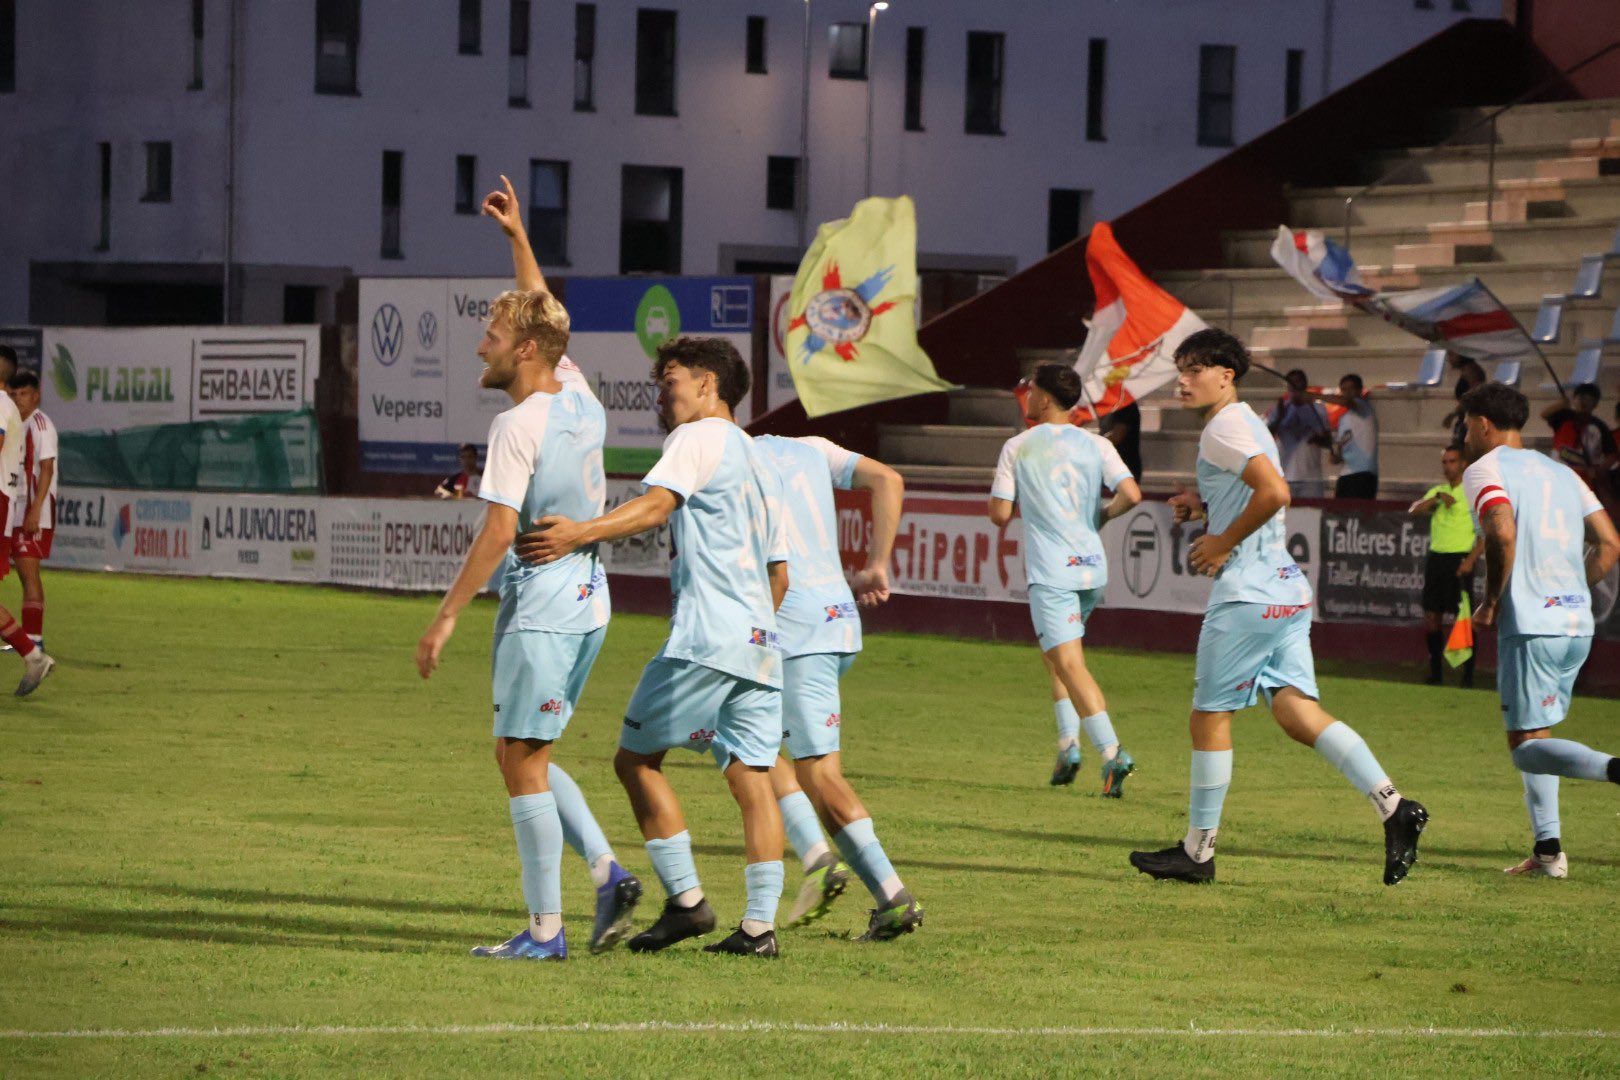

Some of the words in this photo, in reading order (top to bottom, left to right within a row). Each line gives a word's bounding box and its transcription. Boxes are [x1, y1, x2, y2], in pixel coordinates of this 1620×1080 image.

[454, 294, 489, 322] Vep
[200, 369, 296, 400] EMBALAXE
[598, 371, 658, 411] buscas
[372, 394, 443, 422] Vepersa
[216, 506, 234, 539] LA
[237, 507, 317, 543] JUNQUERA
[1540, 479, 1571, 550] 4
[384, 512, 474, 556] DEPUTACIÓN
[1326, 518, 1396, 556] Talleres
[1400, 522, 1432, 557] Fer
[1326, 561, 1359, 586] Taller
[1361, 563, 1426, 590] Autorizado
